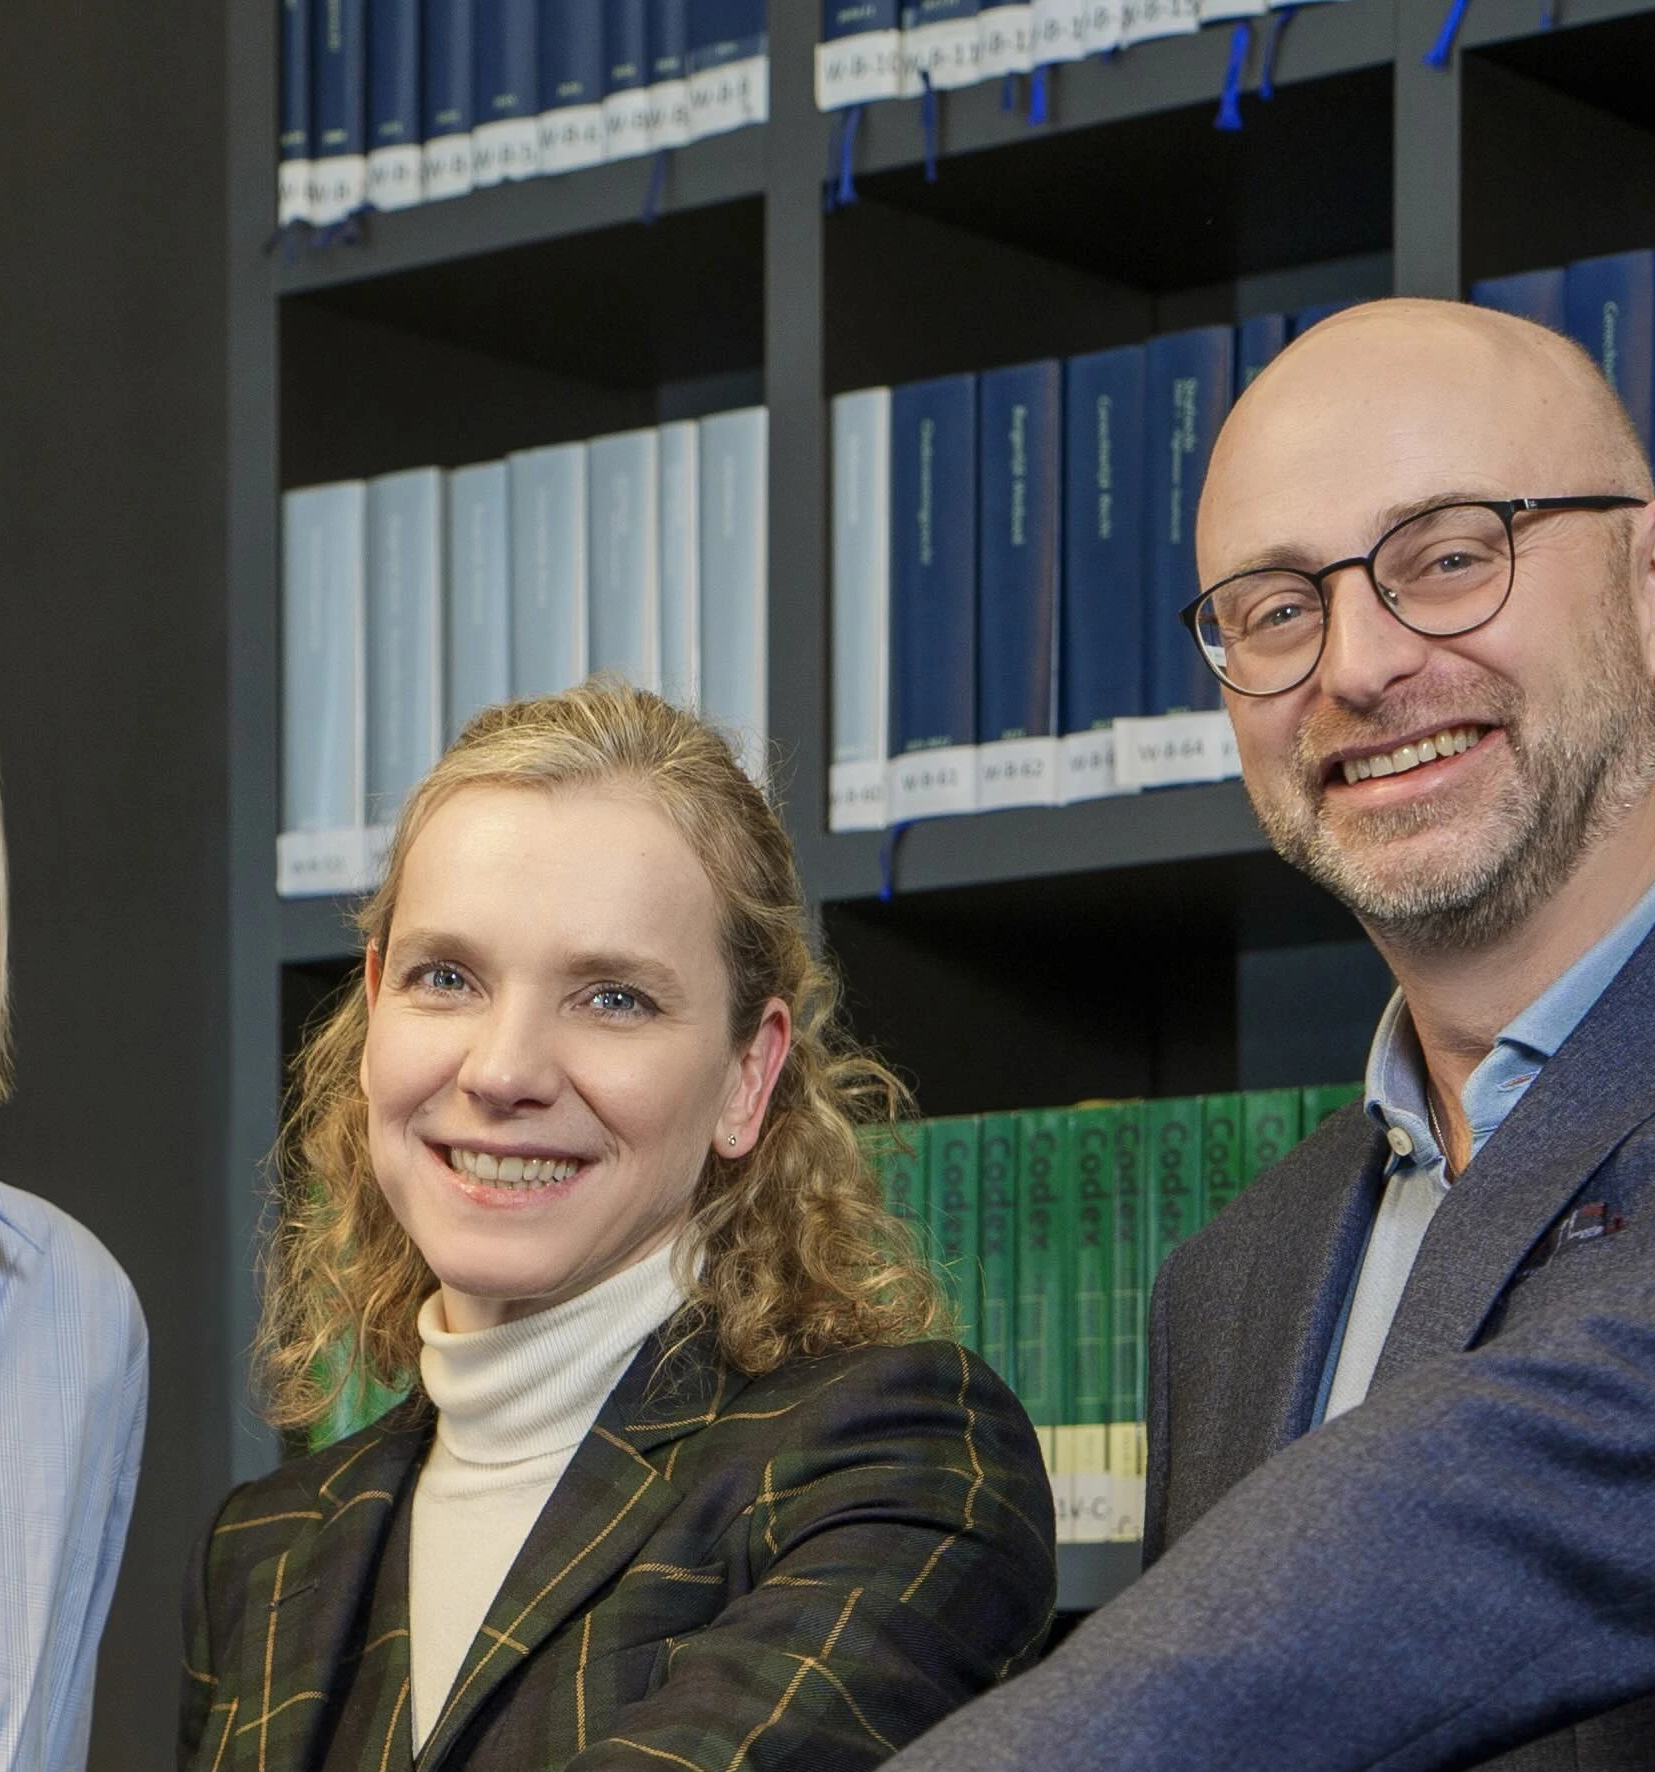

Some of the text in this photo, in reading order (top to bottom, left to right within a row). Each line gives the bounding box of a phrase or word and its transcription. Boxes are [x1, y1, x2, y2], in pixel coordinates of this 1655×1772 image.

[1027, 1131, 1056, 1251] Codex
[1079, 1128, 1108, 1249] Codex
[1208, 1117, 1236, 1215] Code
